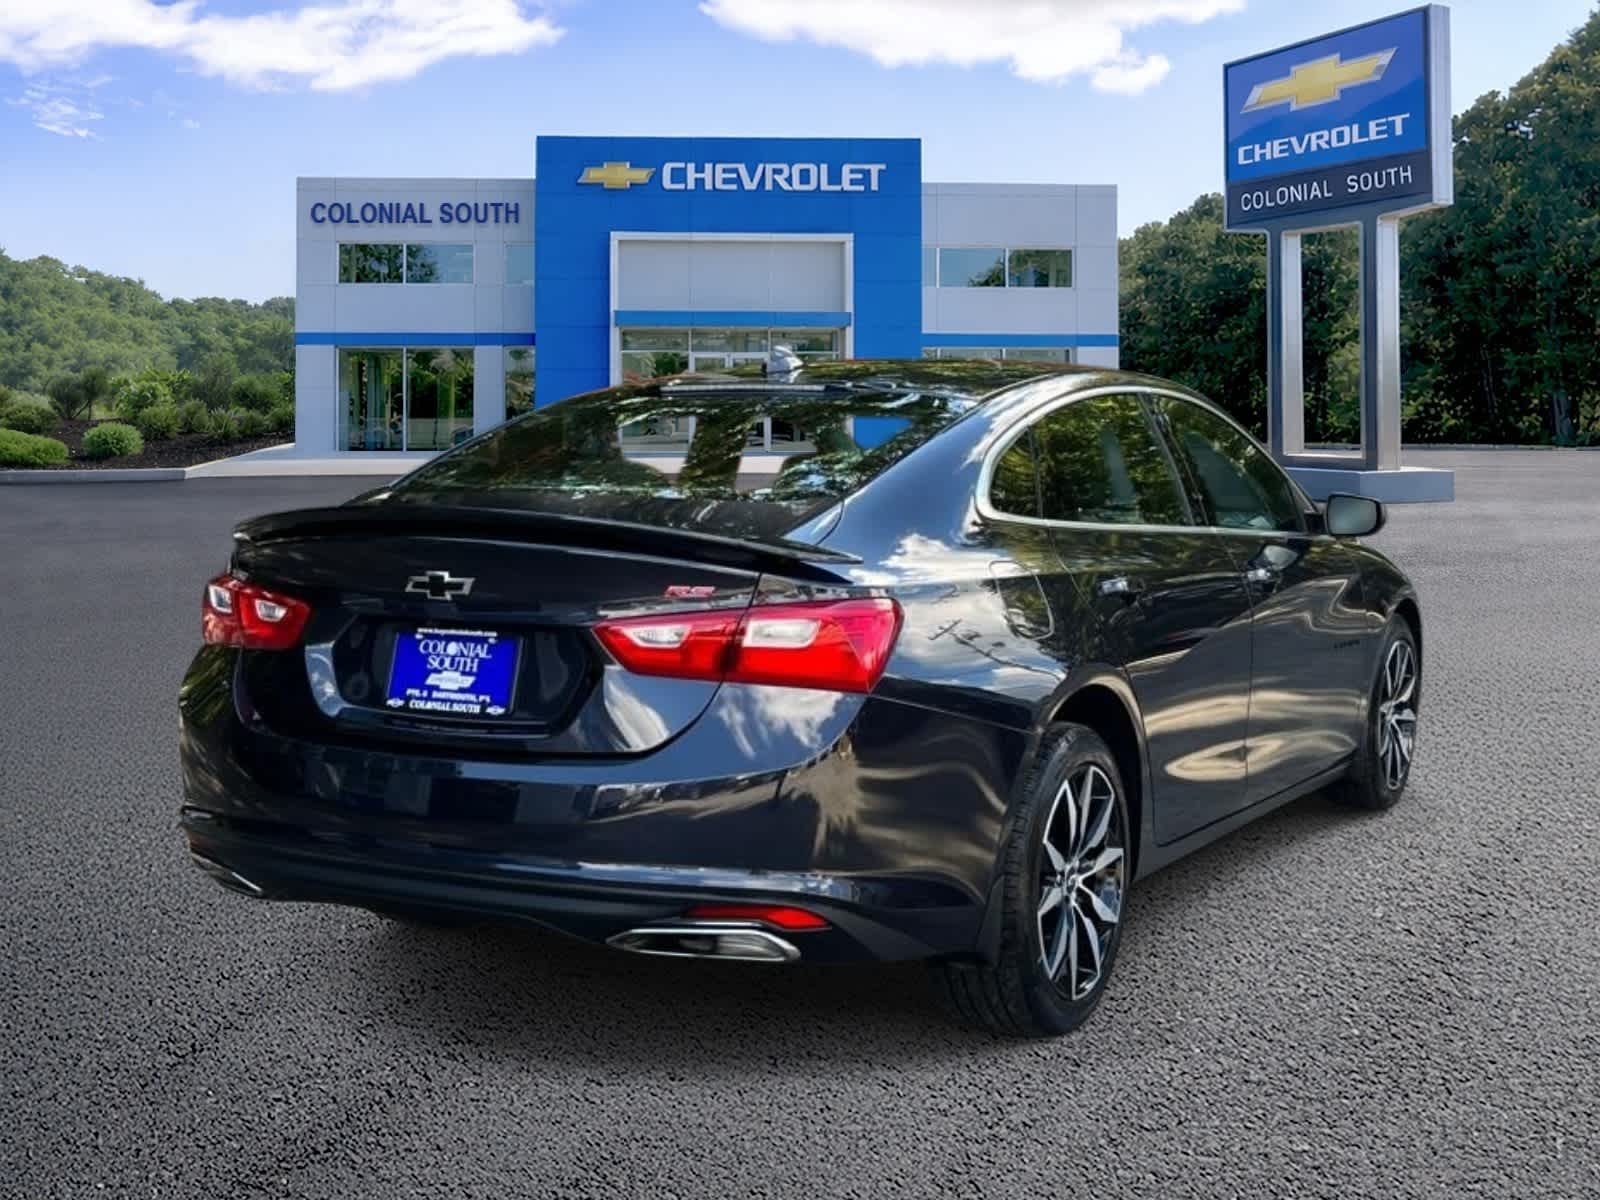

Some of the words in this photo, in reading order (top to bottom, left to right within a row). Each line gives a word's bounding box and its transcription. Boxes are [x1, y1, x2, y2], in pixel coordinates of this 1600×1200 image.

[1238, 113, 1410, 165] CHEVROLET
[662, 162, 887, 192] CHEVROLET
[1240, 179, 1333, 211] COLONIAL
[1346, 165, 1413, 194] SOUTH
[310, 202, 433, 225] COLONIAL
[439, 202, 520, 225] SOUTH
[419, 639, 492, 659] COLONIAL
[426, 655, 480, 673] SOUTH
